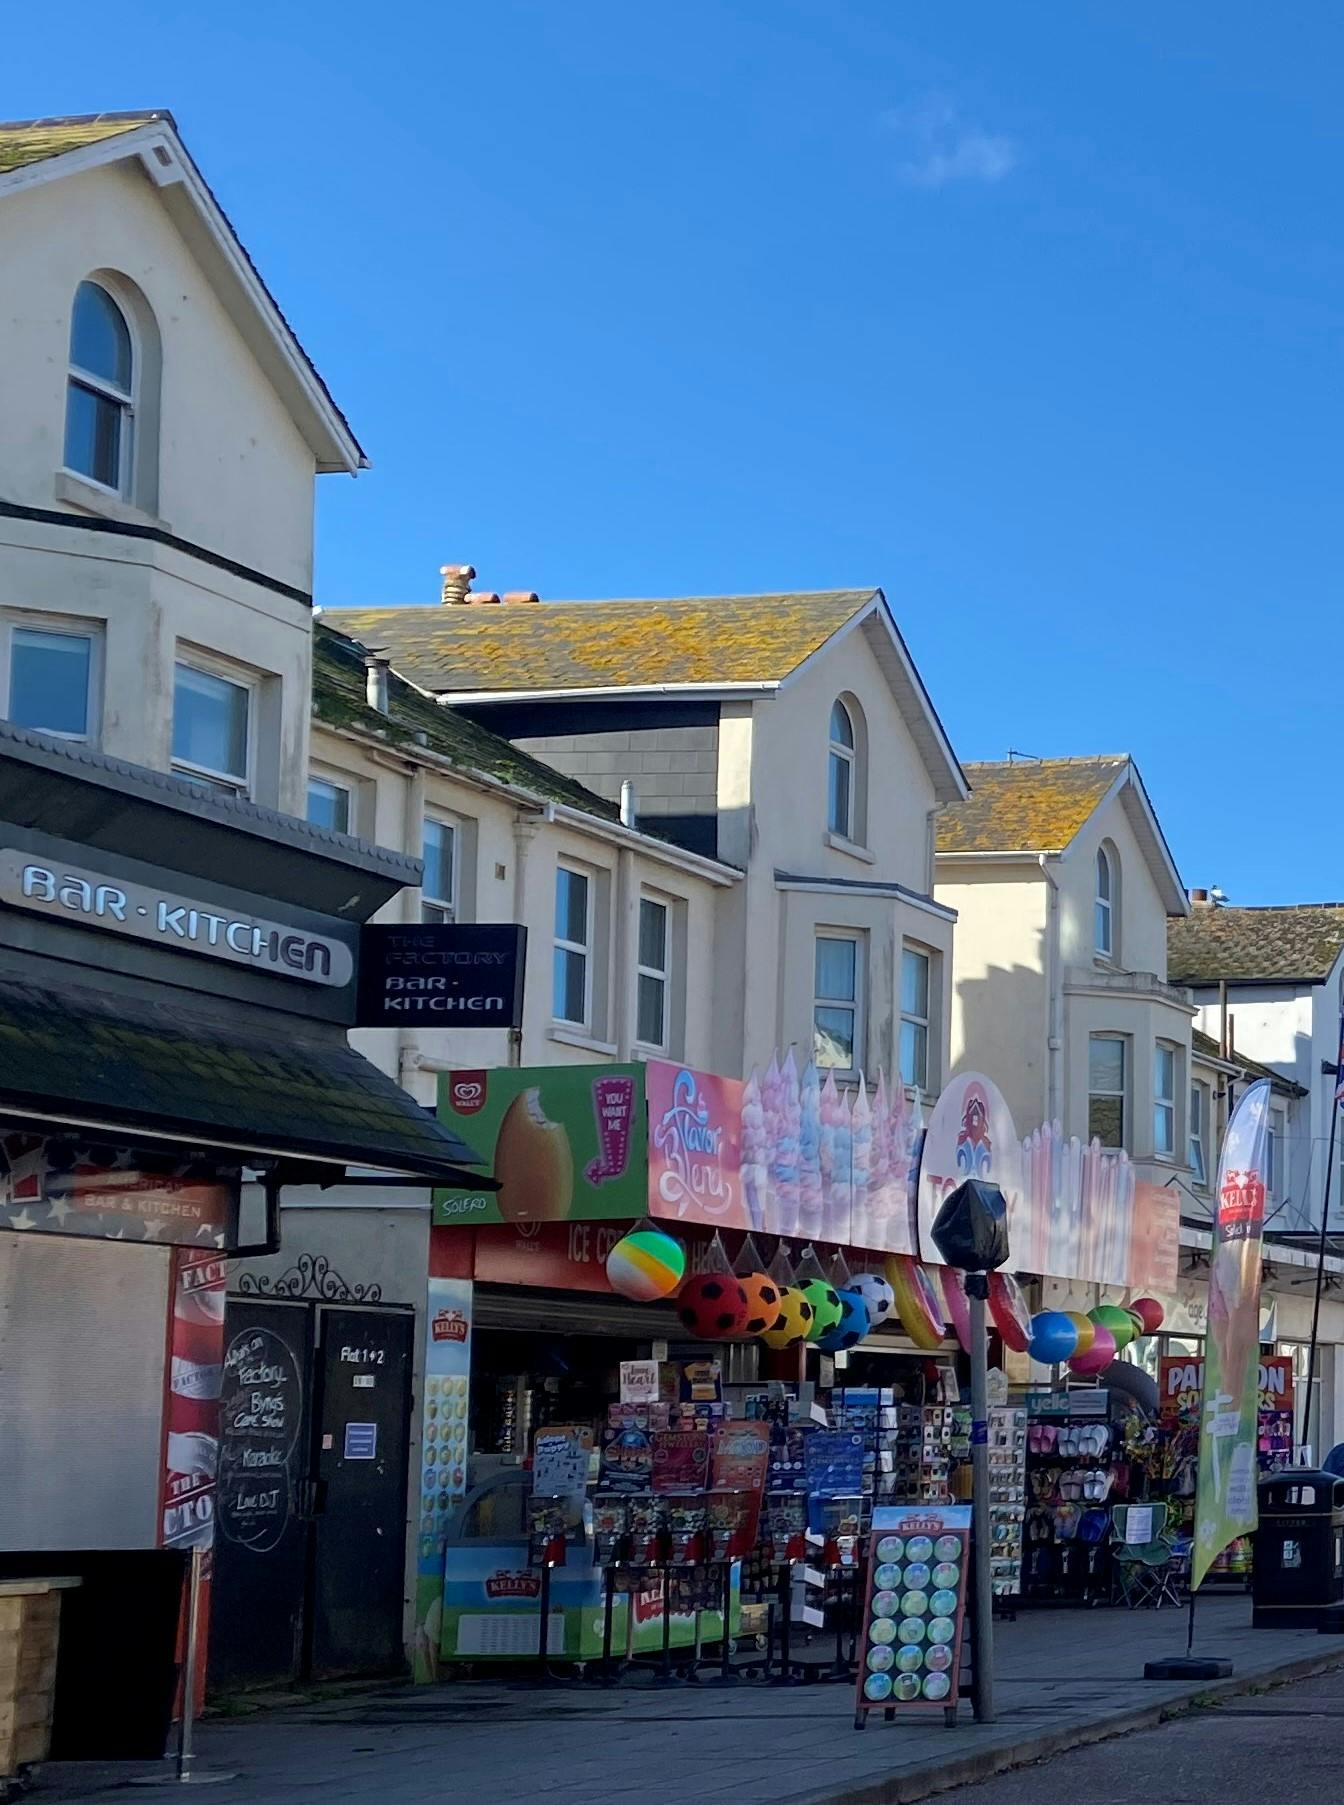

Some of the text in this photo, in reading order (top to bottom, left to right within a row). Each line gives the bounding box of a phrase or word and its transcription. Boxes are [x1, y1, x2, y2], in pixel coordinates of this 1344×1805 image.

[605, 1093, 624, 1103] YOU
[602, 1105, 627, 1118] WANT
[607, 1119, 623, 1132] ME
[138, 1200, 201, 1218] KITCHEN
[568, 1224, 590, 1262] ICE
